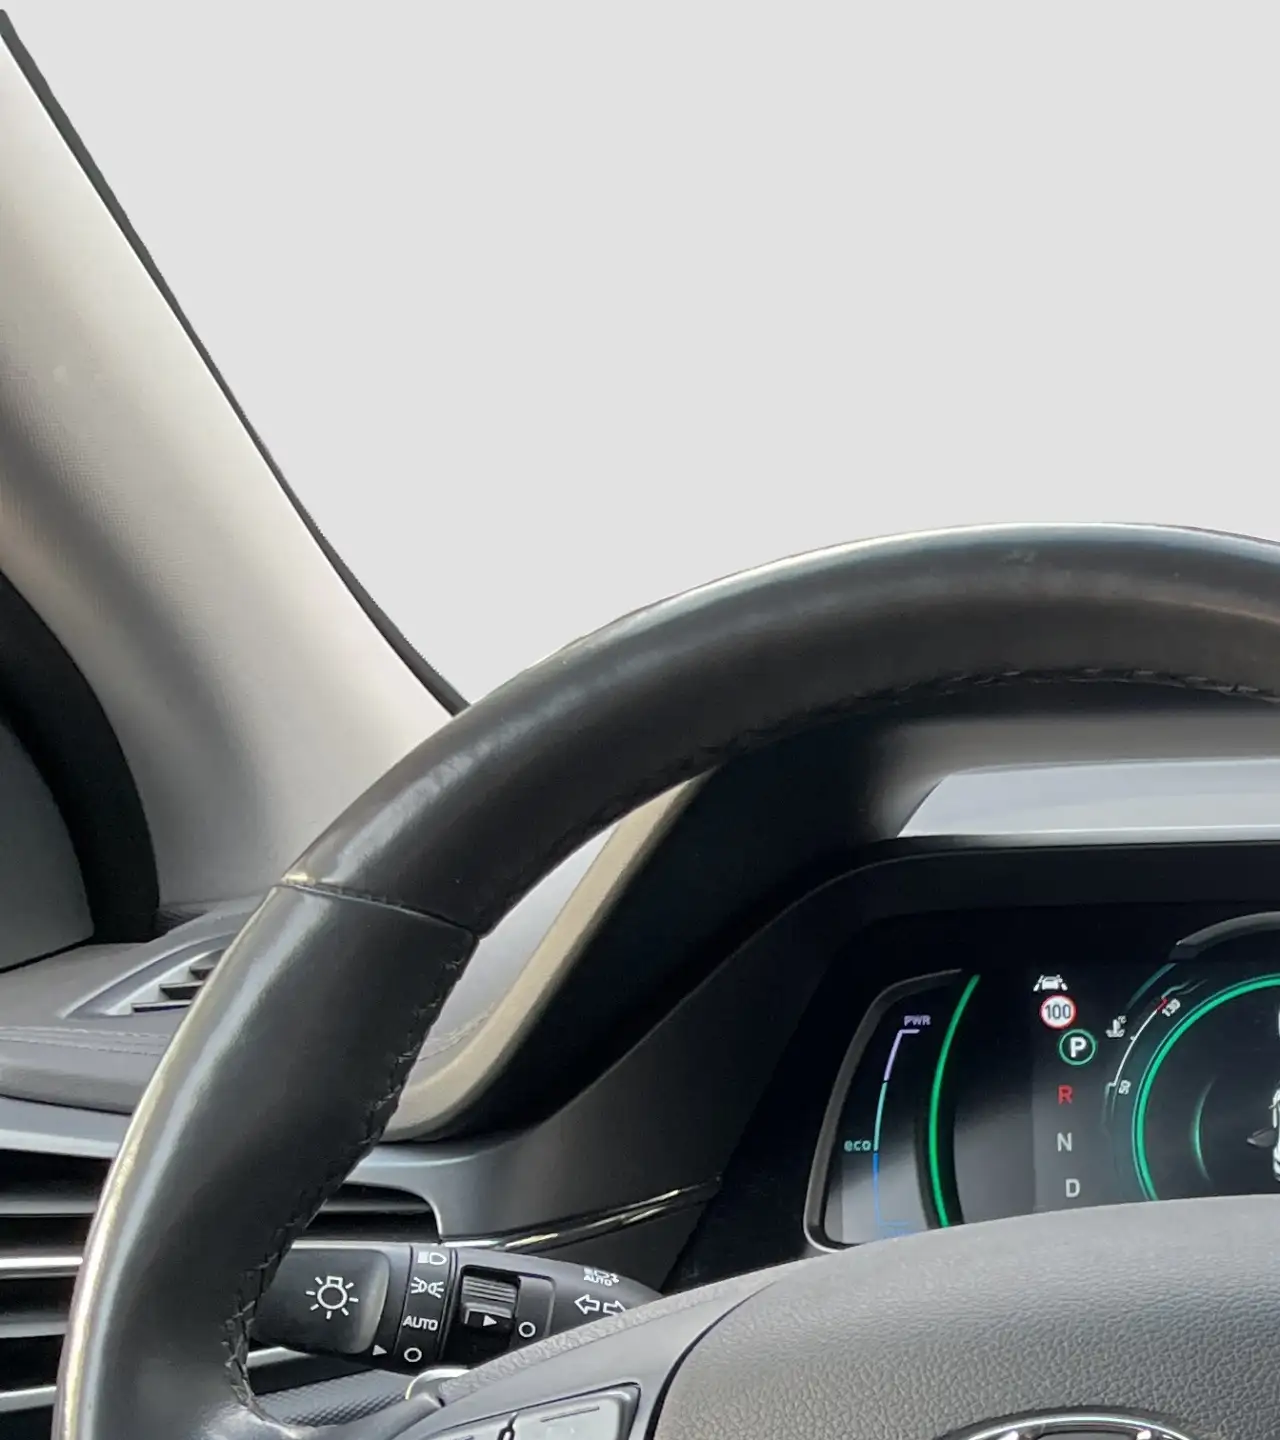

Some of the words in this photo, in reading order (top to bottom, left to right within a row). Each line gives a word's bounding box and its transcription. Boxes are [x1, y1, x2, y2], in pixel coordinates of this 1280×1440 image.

[904, 1015, 931, 1026] PWR
[1044, 1003, 1072, 1021] 100
[1070, 1037, 1087, 1057] P
[1058, 1085, 1072, 1104] R
[844, 1140, 871, 1152] eco
[1057, 1133, 1072, 1152] N
[1066, 1178, 1080, 1197] D
[583, 1275, 613, 1286] AUTO
[403, 1316, 438, 1331] AUTO
